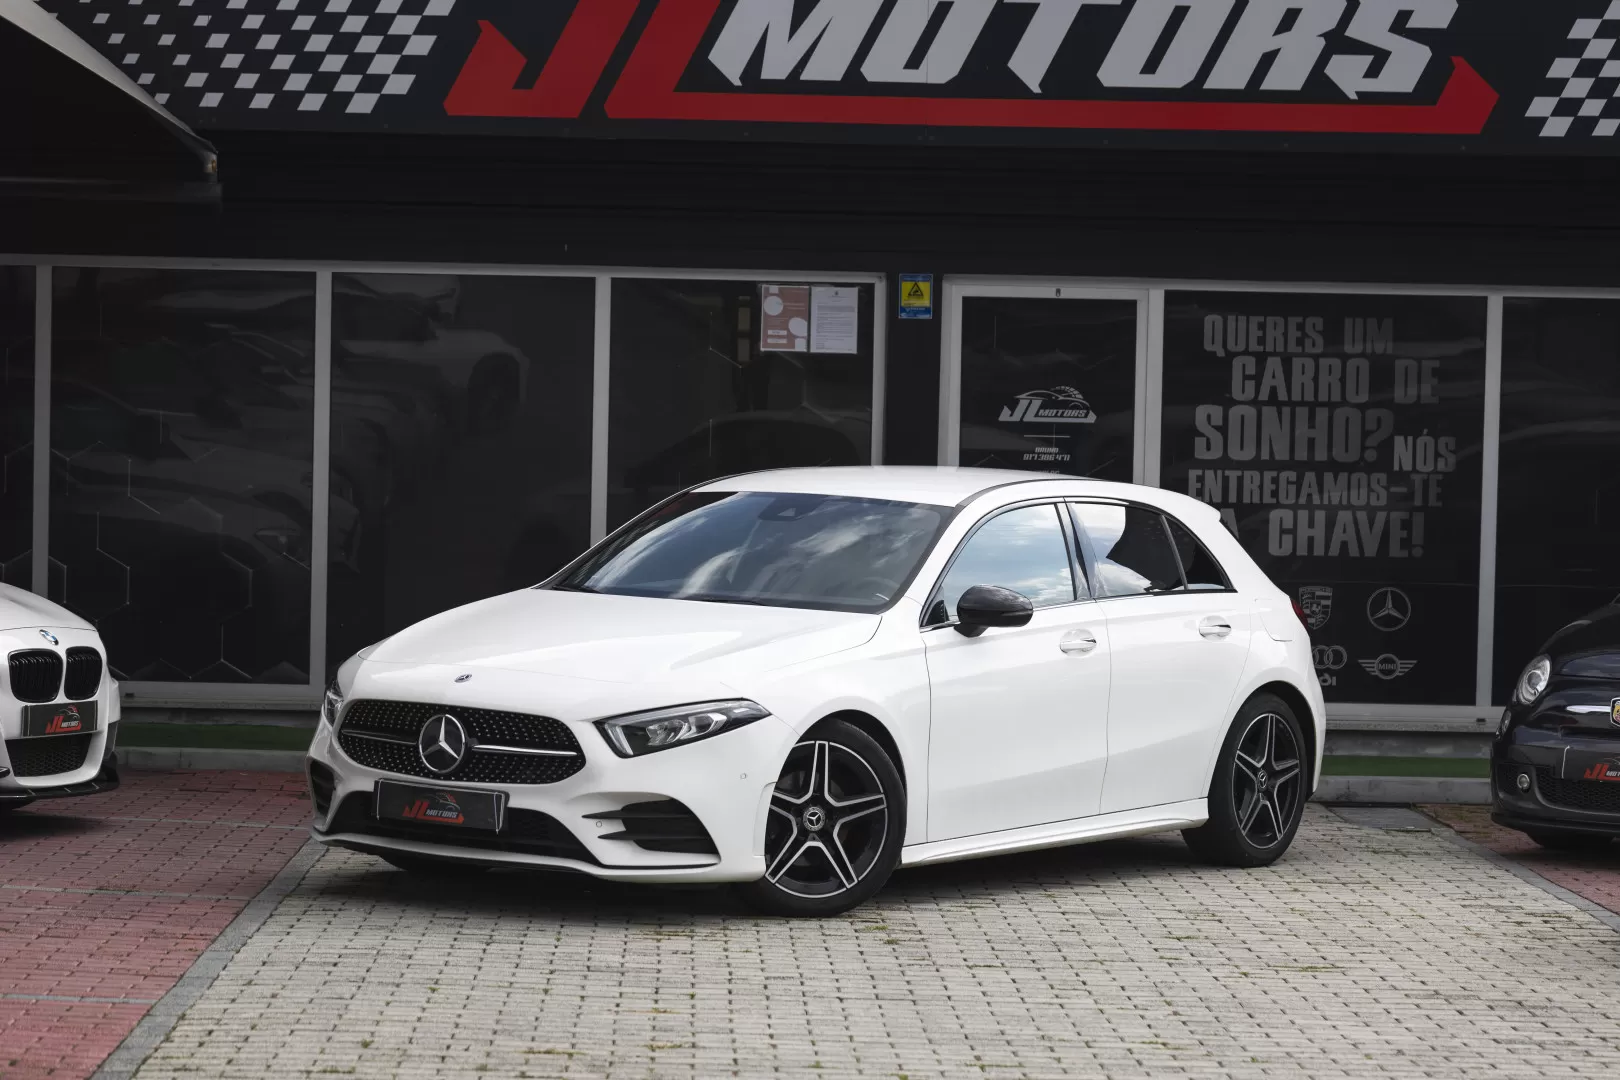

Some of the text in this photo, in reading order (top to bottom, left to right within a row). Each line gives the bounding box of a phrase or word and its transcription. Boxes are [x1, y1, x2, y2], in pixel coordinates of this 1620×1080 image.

[443, 0, 1459, 119] JL MOTORS
[1203, 314, 1393, 357] QUERES UM
[1232, 355, 1441, 404] CARRO DE
[998, 399, 1087, 422] JL MOTORS
[1194, 404, 1394, 463] SONHO?
[1393, 428, 1457, 473] NÓS
[1188, 469, 1444, 507] ENTREGAMOS-TE
[1268, 508, 1425, 558] CHAVE!
[426, 809, 458, 818] MOTORS
